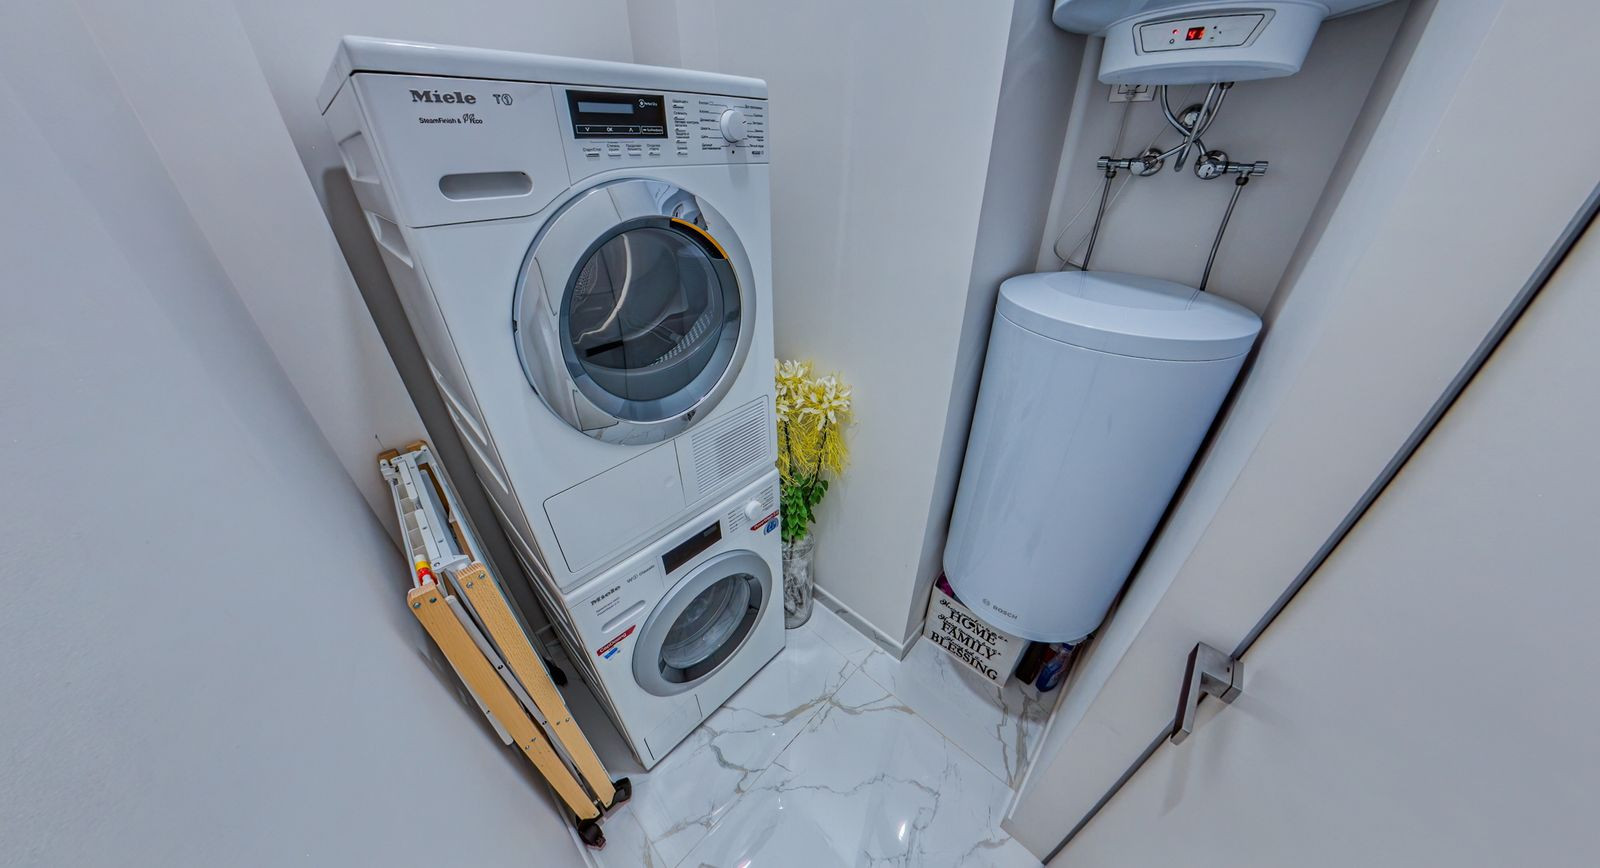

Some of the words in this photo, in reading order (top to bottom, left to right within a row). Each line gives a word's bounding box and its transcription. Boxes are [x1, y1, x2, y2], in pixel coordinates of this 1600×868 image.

[409, 89, 476, 104] Miele
[590, 585, 621, 605] Miele
[992, 605, 1018, 620] BOSCH
[941, 620, 998, 660] FAMILY
[950, 610, 998, 645] HOME
[930, 630, 998, 680] BLESSING
